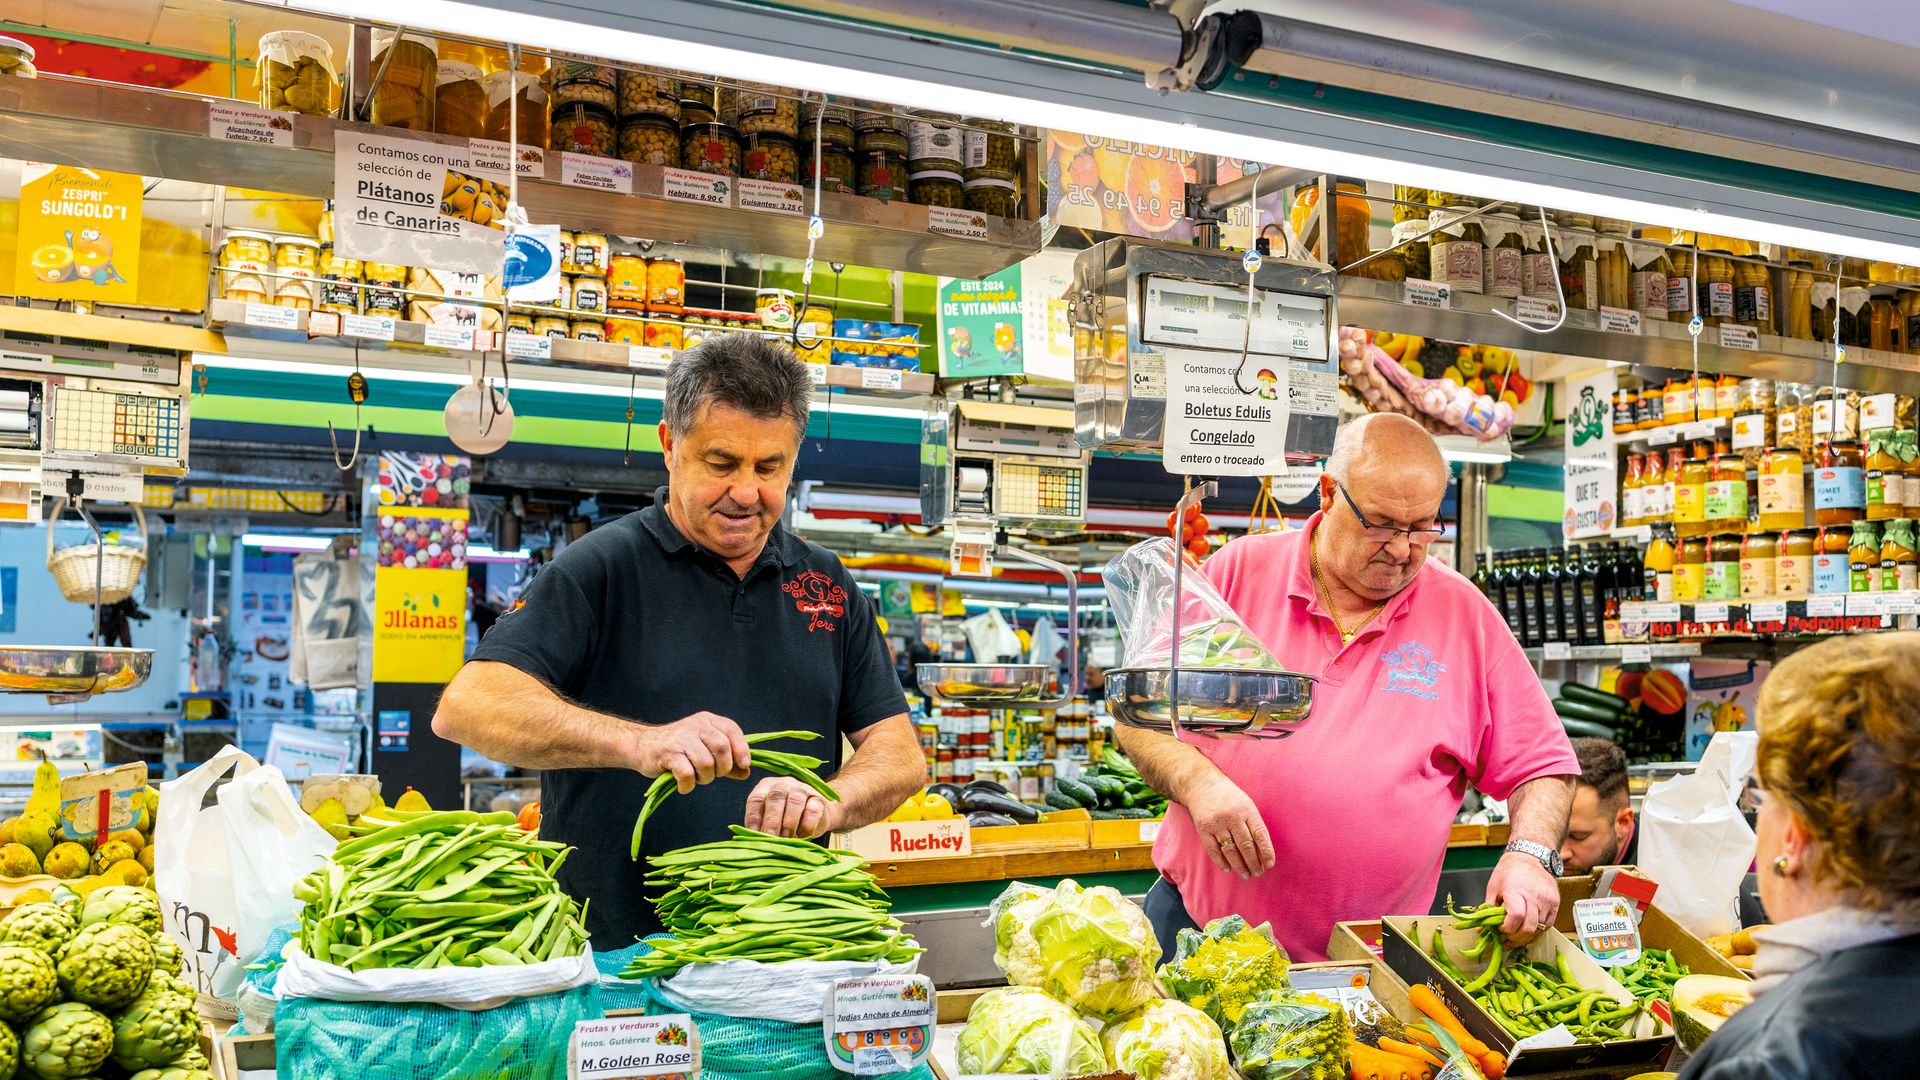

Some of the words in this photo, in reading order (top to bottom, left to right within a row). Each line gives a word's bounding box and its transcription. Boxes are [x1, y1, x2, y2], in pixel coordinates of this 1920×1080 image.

[227, 126, 264, 136] Alcachofas
[358, 142, 419, 162] Contamos
[422, 153, 444, 165] con
[448, 157, 470, 168] una
[475, 159, 503, 169] Cardo:
[588, 160, 614, 168] Verduras
[357, 161, 413, 178] selección
[417, 168, 432, 181] de
[689, 174, 714, 183] Verduras
[684, 181, 709, 190] Gutiérrez
[357, 180, 435, 205] Plátanos
[668, 189, 698, 199] Habitas:
[700, 193, 717, 202] 8,90
[741, 198, 779, 209] Guisantes:
[780, 203, 796, 211] 3,25
[356, 206, 379, 223] de
[384, 210, 460, 233] Canarias
[931, 225, 965, 234] Guisantes:
[961, 281, 981, 291] ESTE
[982, 281, 1004, 291] 2024
[944, 303, 959, 316] DE
[961, 301, 1022, 316] VITAMINAS
[1184, 363, 1226, 375] Contamos
[1228, 367, 1243, 376] con
[1184, 385, 1200, 393] una
[1202, 384, 1240, 395] selección
[1185, 403, 1232, 417] Boletus
[1236, 405, 1271, 420] Edulis
[1190, 429, 1255, 445] Congelado
[1180, 453, 1213, 464] entero
[1214, 455, 1220, 464] o
[1223, 453, 1265, 466] troceado
[1577, 484, 1589, 502] QUE
[1591, 482, 1599, 499] TE
[1578, 510, 1597, 528] GUSTA
[1652, 622, 1673, 638] Ajo
[1757, 618, 1784, 633] Las
[890, 828, 962, 852] Ruchey
[1586, 921, 1626, 932] Guisantes
[1603, 937, 1608, 946] 9
[837, 980, 861, 989] Frutas
[861, 992, 897, 1001] Gutiérrez
[863, 1011, 890, 1019] Anchas
[902, 1007, 929, 1016] Almería
[580, 1024, 608, 1033] Frutas
[620, 1022, 660, 1030] Verduras
[581, 1040, 605, 1048] Hnos.
[609, 1036, 650, 1046] Gutiérrez
[866, 1032, 874, 1044] 8
[883, 1031, 890, 1039] 9
[900, 1030, 908, 1038] 0
[581, 1054, 649, 1071] M.Golden
[655, 1052, 690, 1064] Rose
